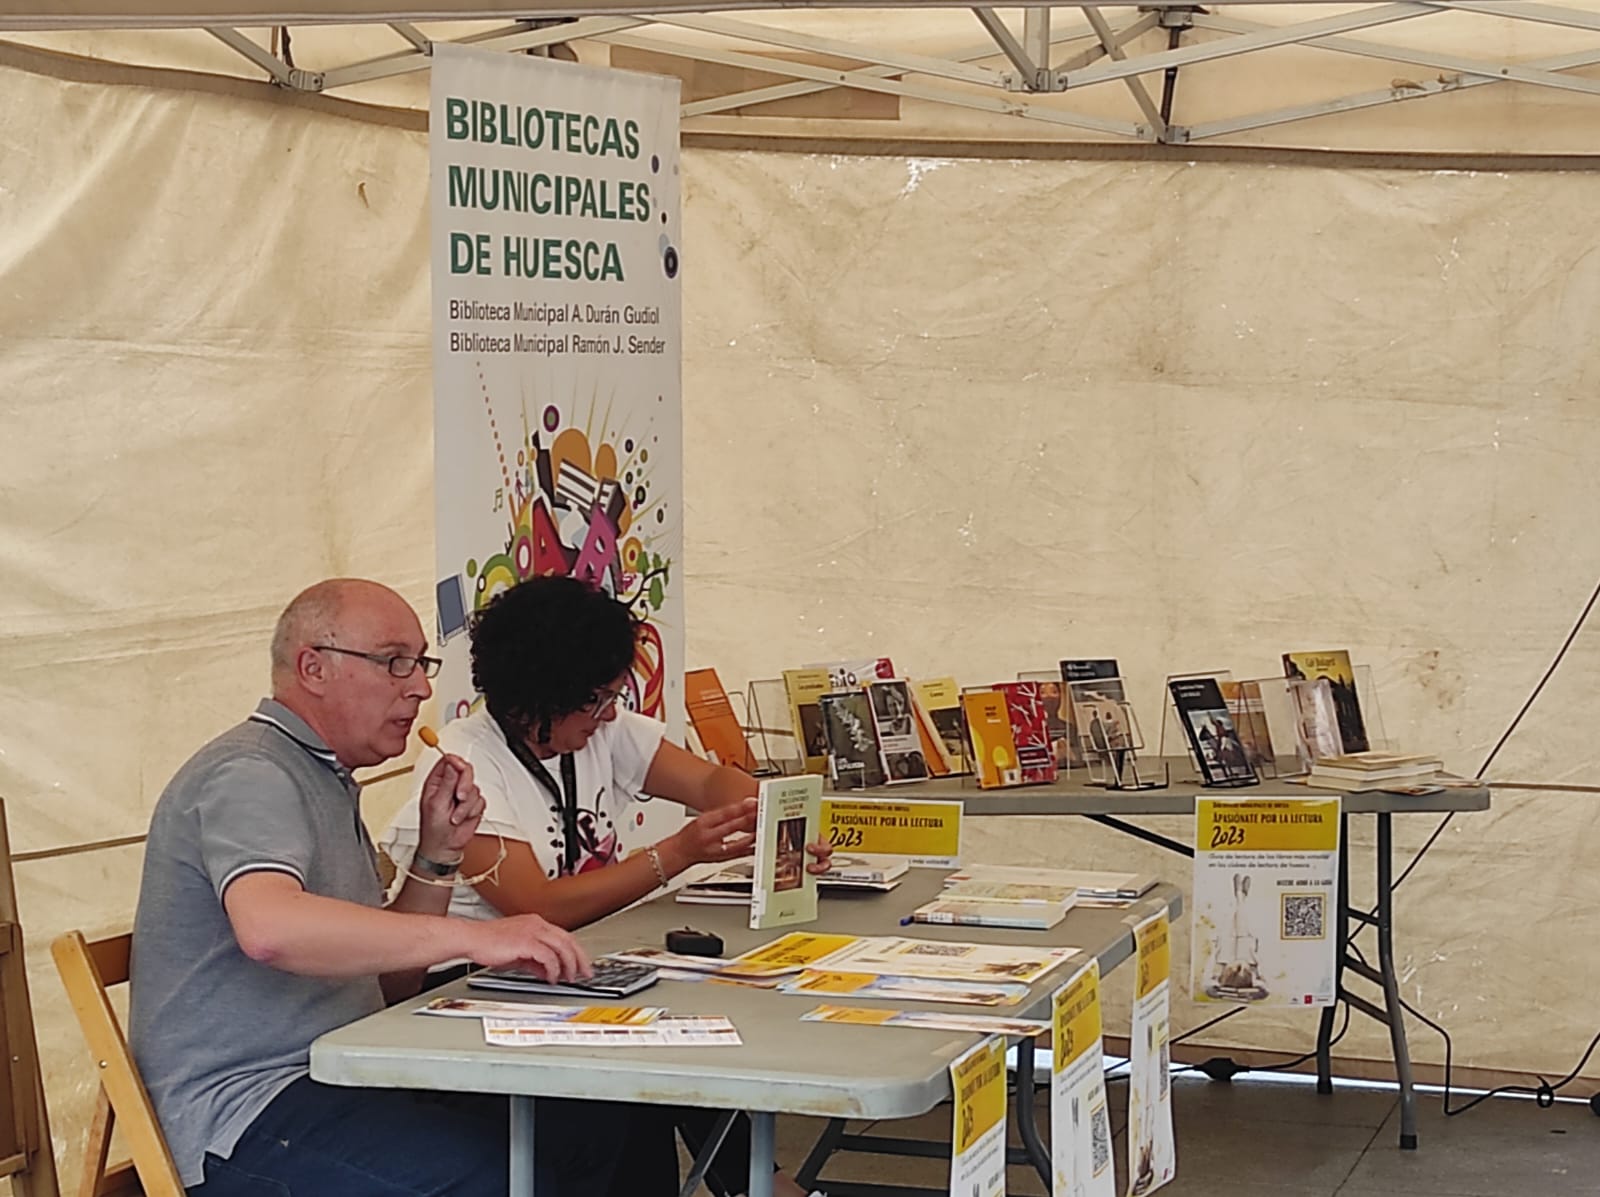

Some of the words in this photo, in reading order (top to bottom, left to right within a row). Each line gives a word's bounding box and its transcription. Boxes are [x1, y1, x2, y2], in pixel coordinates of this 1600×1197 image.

[446, 97, 640, 160] BIBLIOTECAS
[448, 165, 650, 222] MUNICIPALES
[450, 232, 491, 275] DE
[503, 235, 624, 282] HUESCA
[450, 299, 510, 320] Biblioteca
[513, 301, 569, 326] Municipal
[571, 304, 584, 323] A.
[586, 304, 619, 324] Durán
[623, 305, 660, 325] Gudiol
[450, 332, 511, 353] Biblioteca
[513, 333, 569, 357] Municipal
[572, 334, 610, 354] Ramón
[613, 335, 624, 354] J.
[628, 335, 665, 354] Sender
[880, 816, 897, 827] POR
[899, 816, 909, 827] LA
[910, 816, 944, 828] LECTURA
[1261, 813, 1277, 824] POR
[1279, 813, 1289, 823] LA
[1290, 812, 1323, 824] LECTURA
[829, 826, 863, 847] 2023
[1211, 825, 1245, 848] 2023
